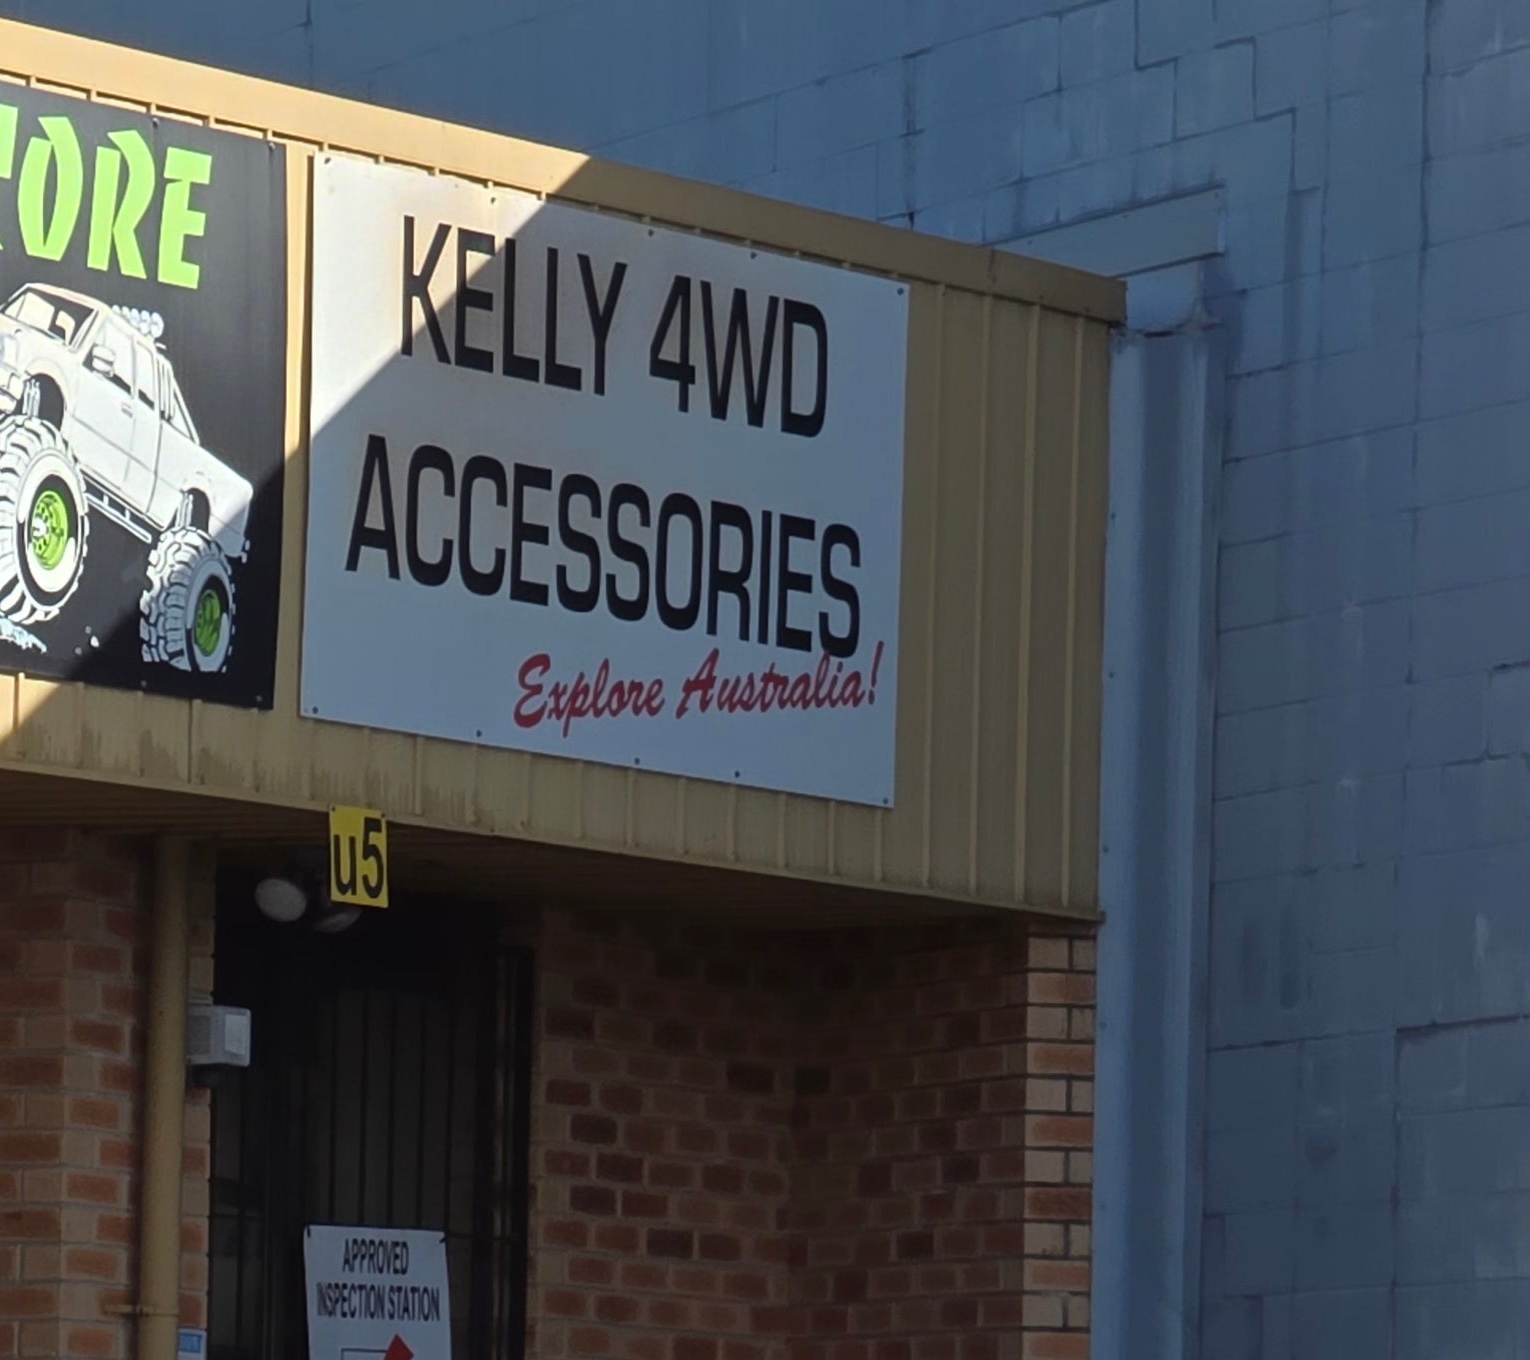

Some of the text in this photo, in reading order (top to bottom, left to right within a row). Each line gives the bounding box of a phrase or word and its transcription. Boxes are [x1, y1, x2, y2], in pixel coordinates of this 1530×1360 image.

[401, 215, 828, 438] KELLY 4WD
[345, 433, 861, 659] ACCESSORIES
[513, 641, 886, 738] Explore Australia!
[317, 1282, 440, 1322] INSPECTION STATION
[342, 1238, 409, 1275] APPROVED
